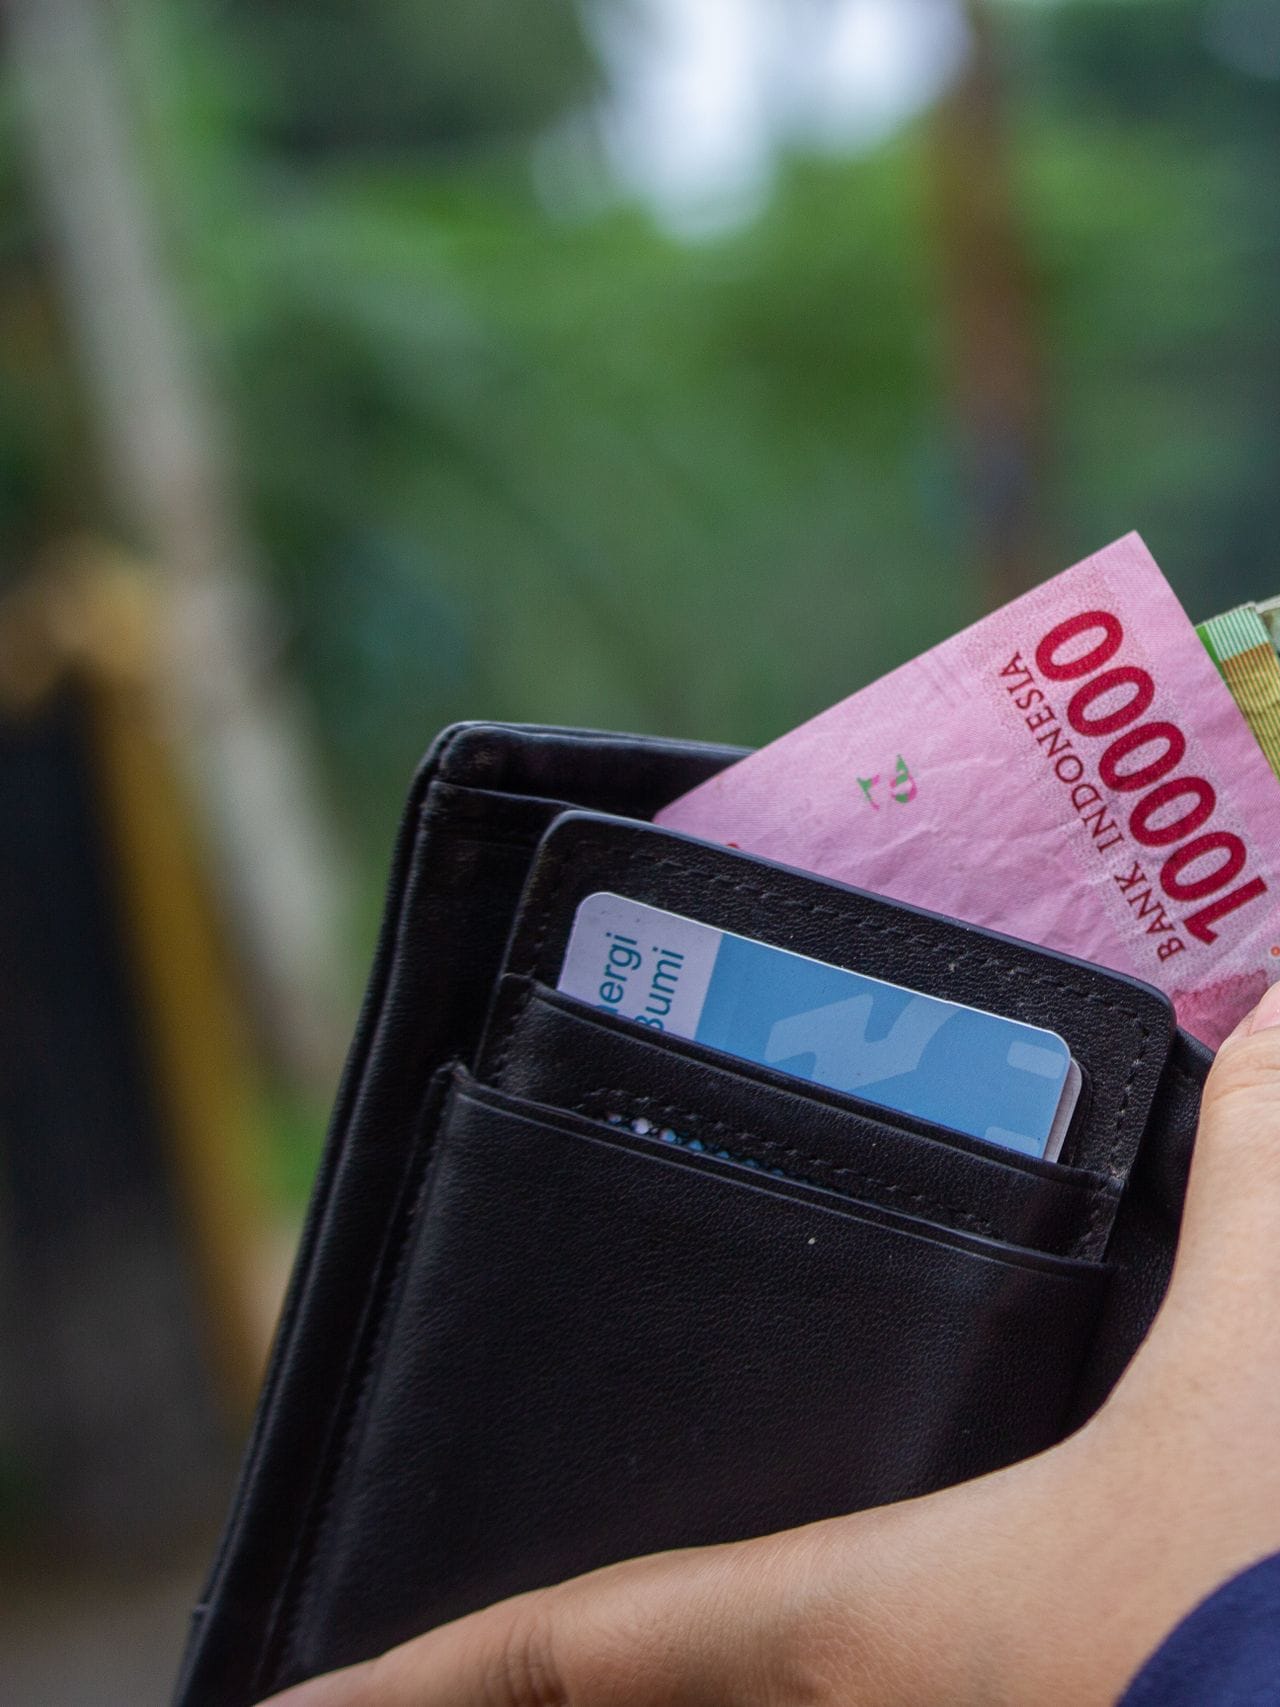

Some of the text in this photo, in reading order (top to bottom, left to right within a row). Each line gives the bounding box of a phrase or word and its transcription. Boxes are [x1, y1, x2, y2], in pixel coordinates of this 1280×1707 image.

[1000, 652, 1185, 962] BANK INDONESIA
[1035, 610, 1267, 945] 100000
